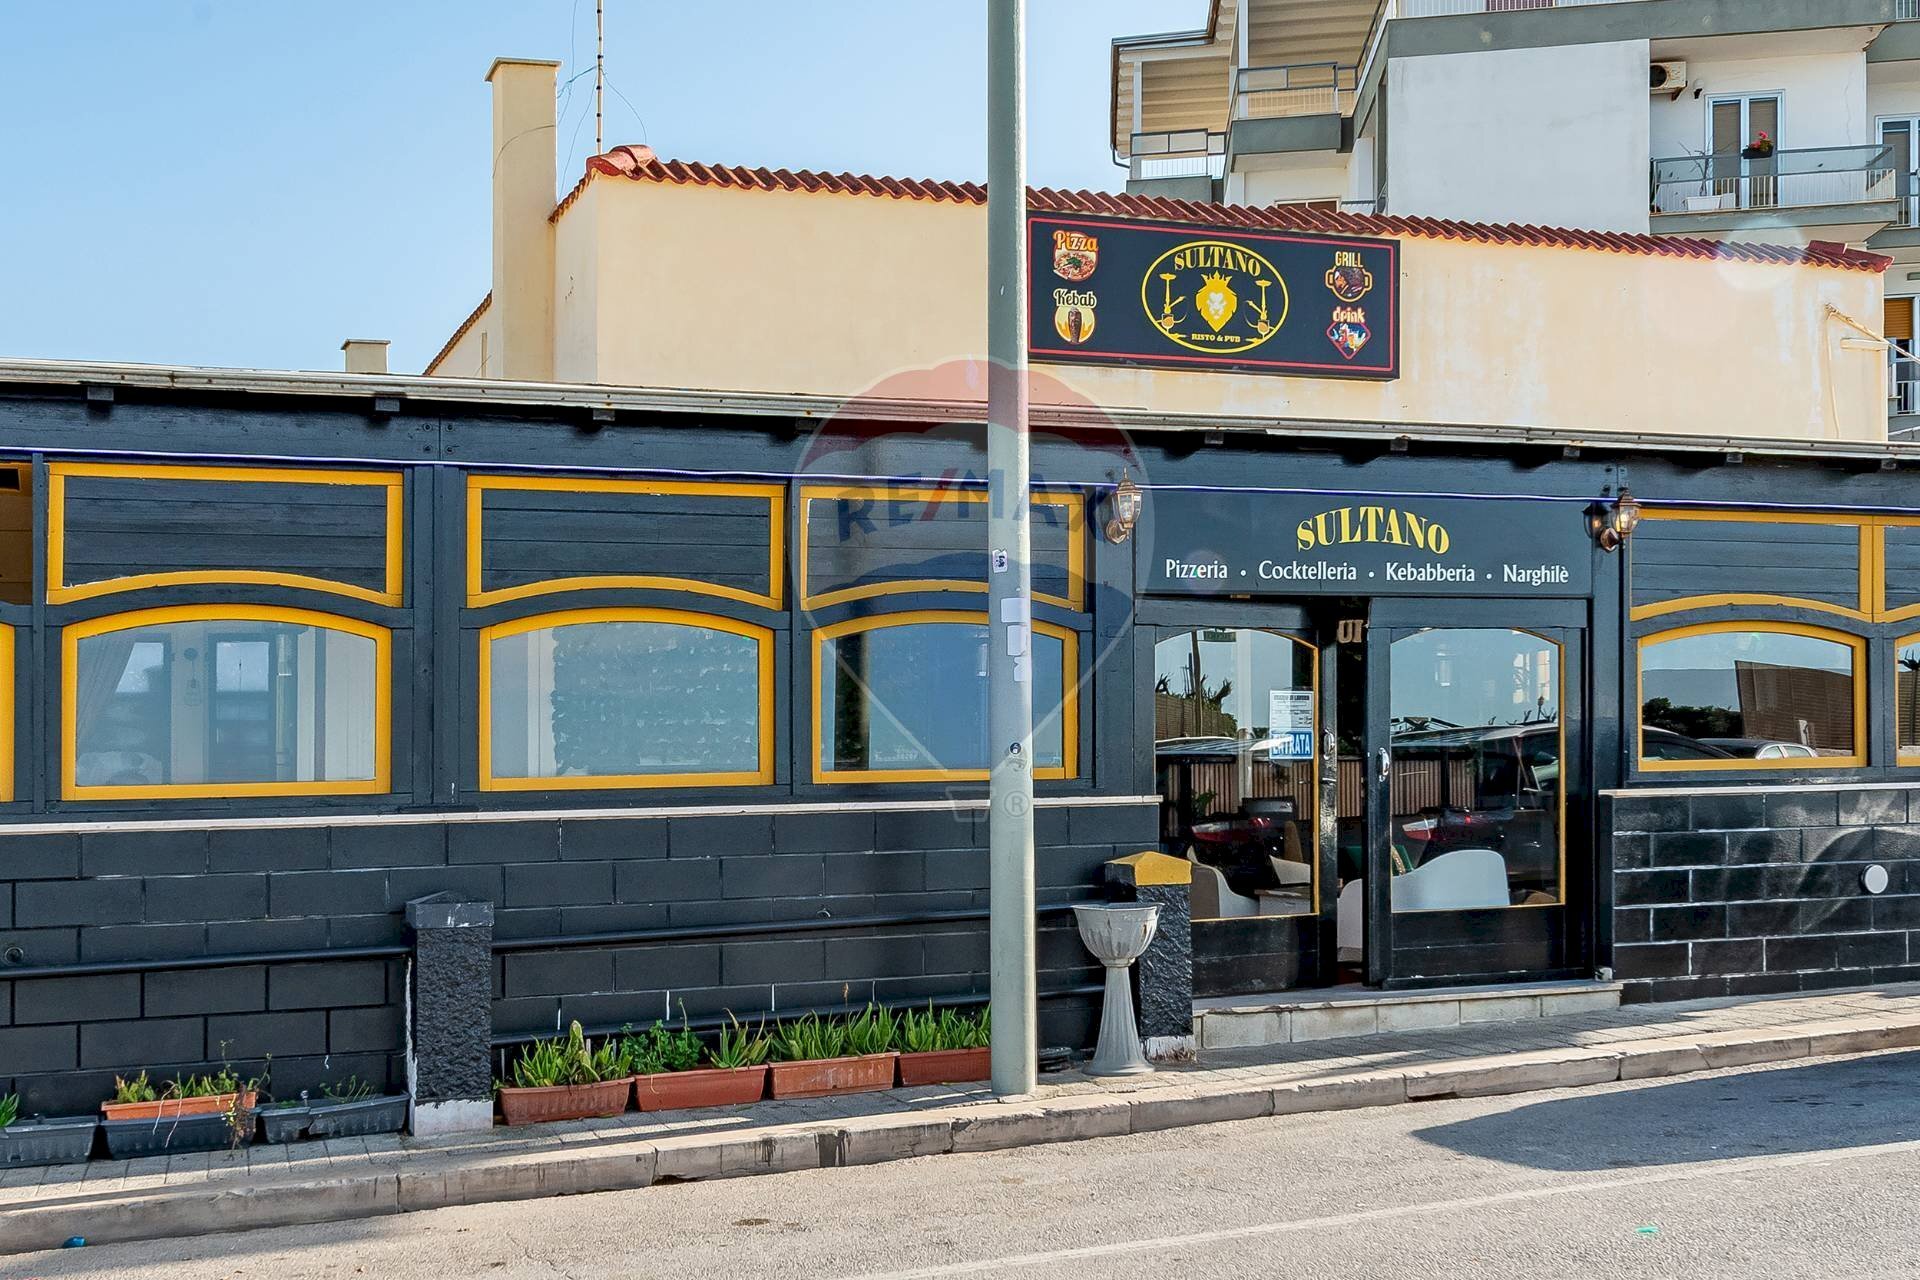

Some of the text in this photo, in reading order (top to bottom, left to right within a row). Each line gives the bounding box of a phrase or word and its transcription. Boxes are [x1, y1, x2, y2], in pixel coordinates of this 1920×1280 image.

[1053, 230, 1099, 252] Pizza
[1174, 246, 1262, 278] SULTANO
[1335, 251, 1363, 268] GRILL
[1053, 288, 1097, 308] Kebab
[1332, 306, 1366, 323] drink
[1191, 333, 1216, 342] RISTO
[1224, 335, 1241, 343] PUB
[1297, 506, 1450, 555] SULTANO
[1165, 559, 1569, 586] Pizzeria Cocktelleria Kebabberia Narghilè
